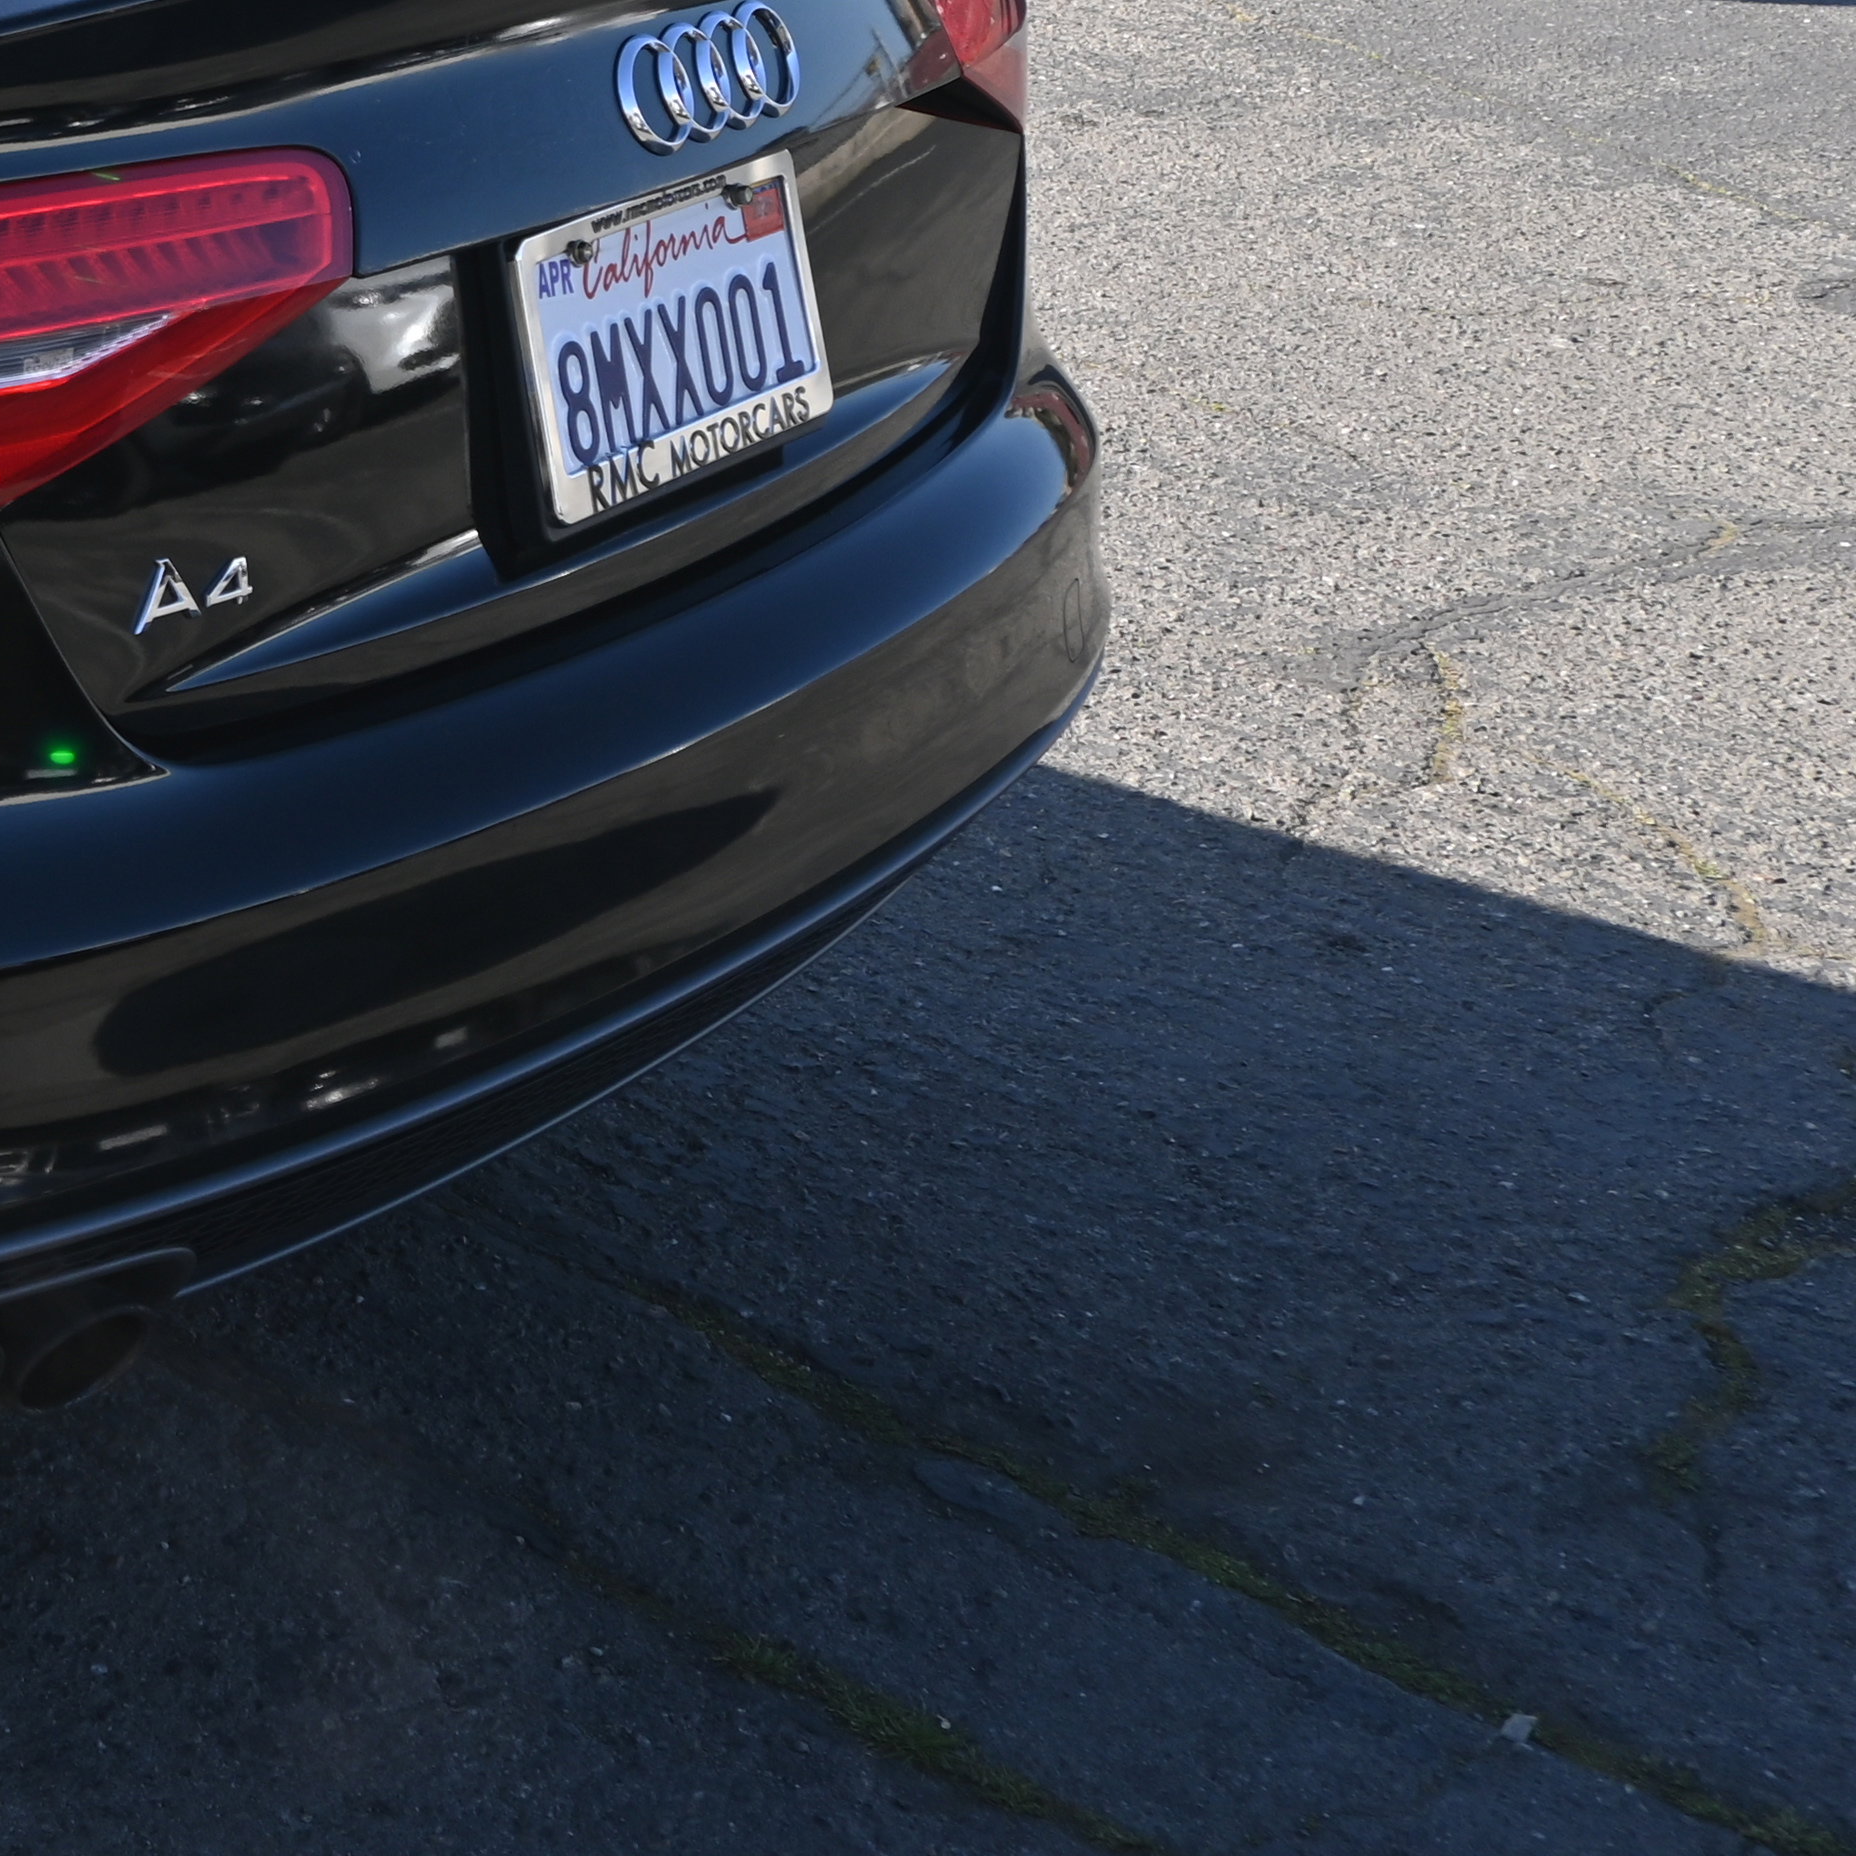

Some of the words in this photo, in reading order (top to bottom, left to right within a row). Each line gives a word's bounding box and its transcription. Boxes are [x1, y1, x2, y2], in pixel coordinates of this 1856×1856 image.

[537, 259, 574, 299] APR
[581, 203, 748, 300] California
[557, 261, 805, 467] 8MXX001
[587, 439, 661, 513] RMC
[671, 385, 811, 480] MOTORCARS
[134, 556, 253, 635] A4
